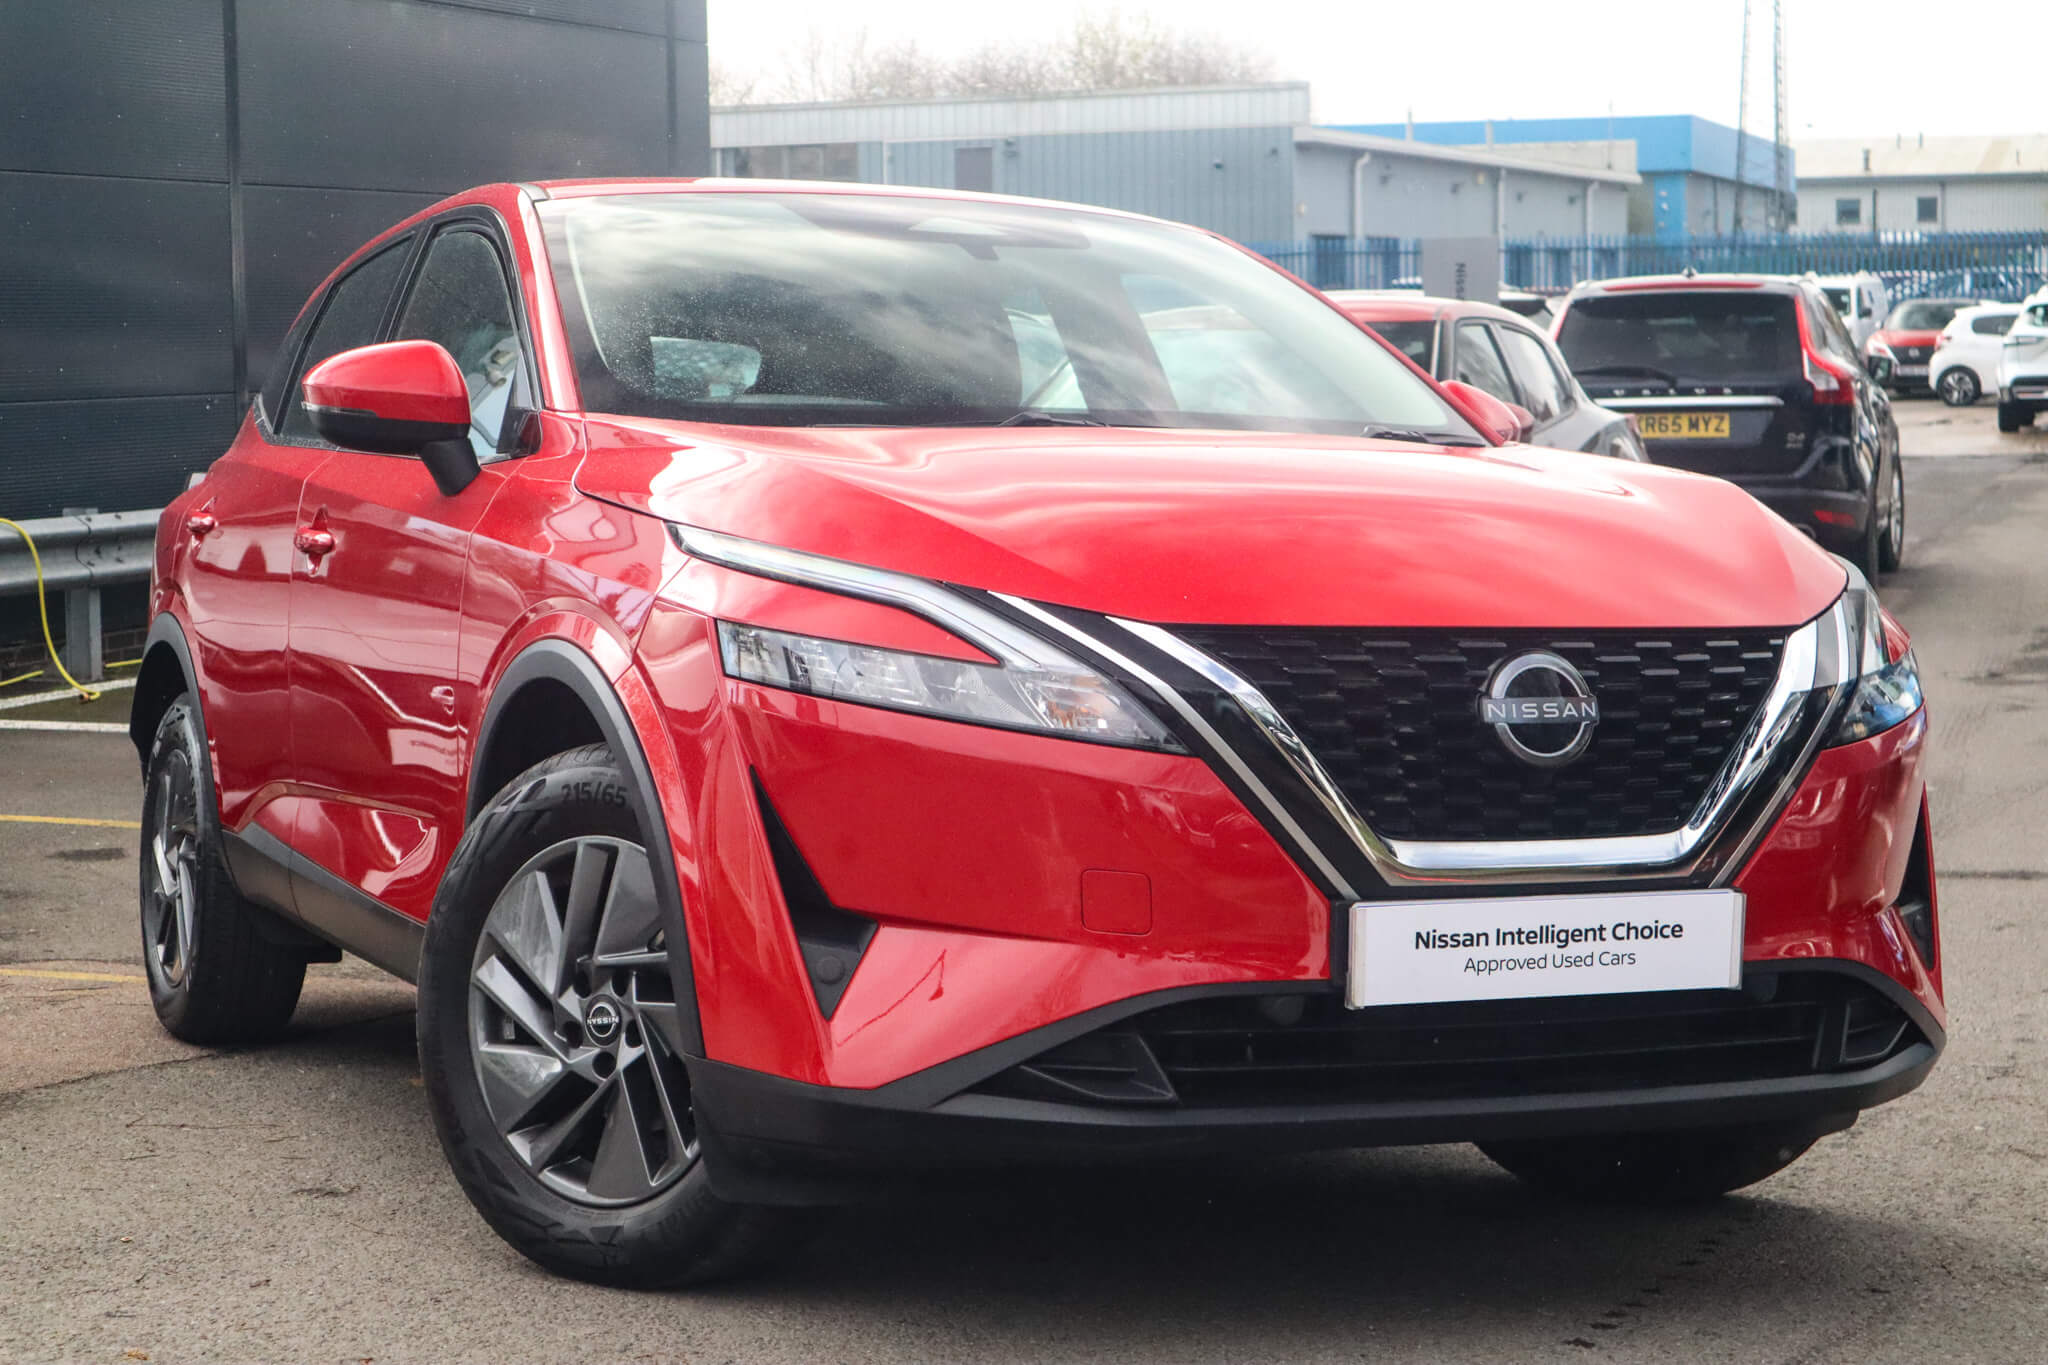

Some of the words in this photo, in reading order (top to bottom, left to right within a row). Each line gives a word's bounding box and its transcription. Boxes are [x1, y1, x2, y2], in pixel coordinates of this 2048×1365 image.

[1687, 414, 1726, 433] MYZ
[1487, 702, 1597, 719] NISSAN
[561, 781, 627, 808] 215/65
[1415, 929, 1490, 950] Nissan
[1495, 924, 1607, 949] Intelligent
[1611, 919, 1684, 941] Choice
[1463, 953, 1548, 977] Approved
[1552, 952, 1594, 969] Used
[1598, 951, 1637, 966] Cars
